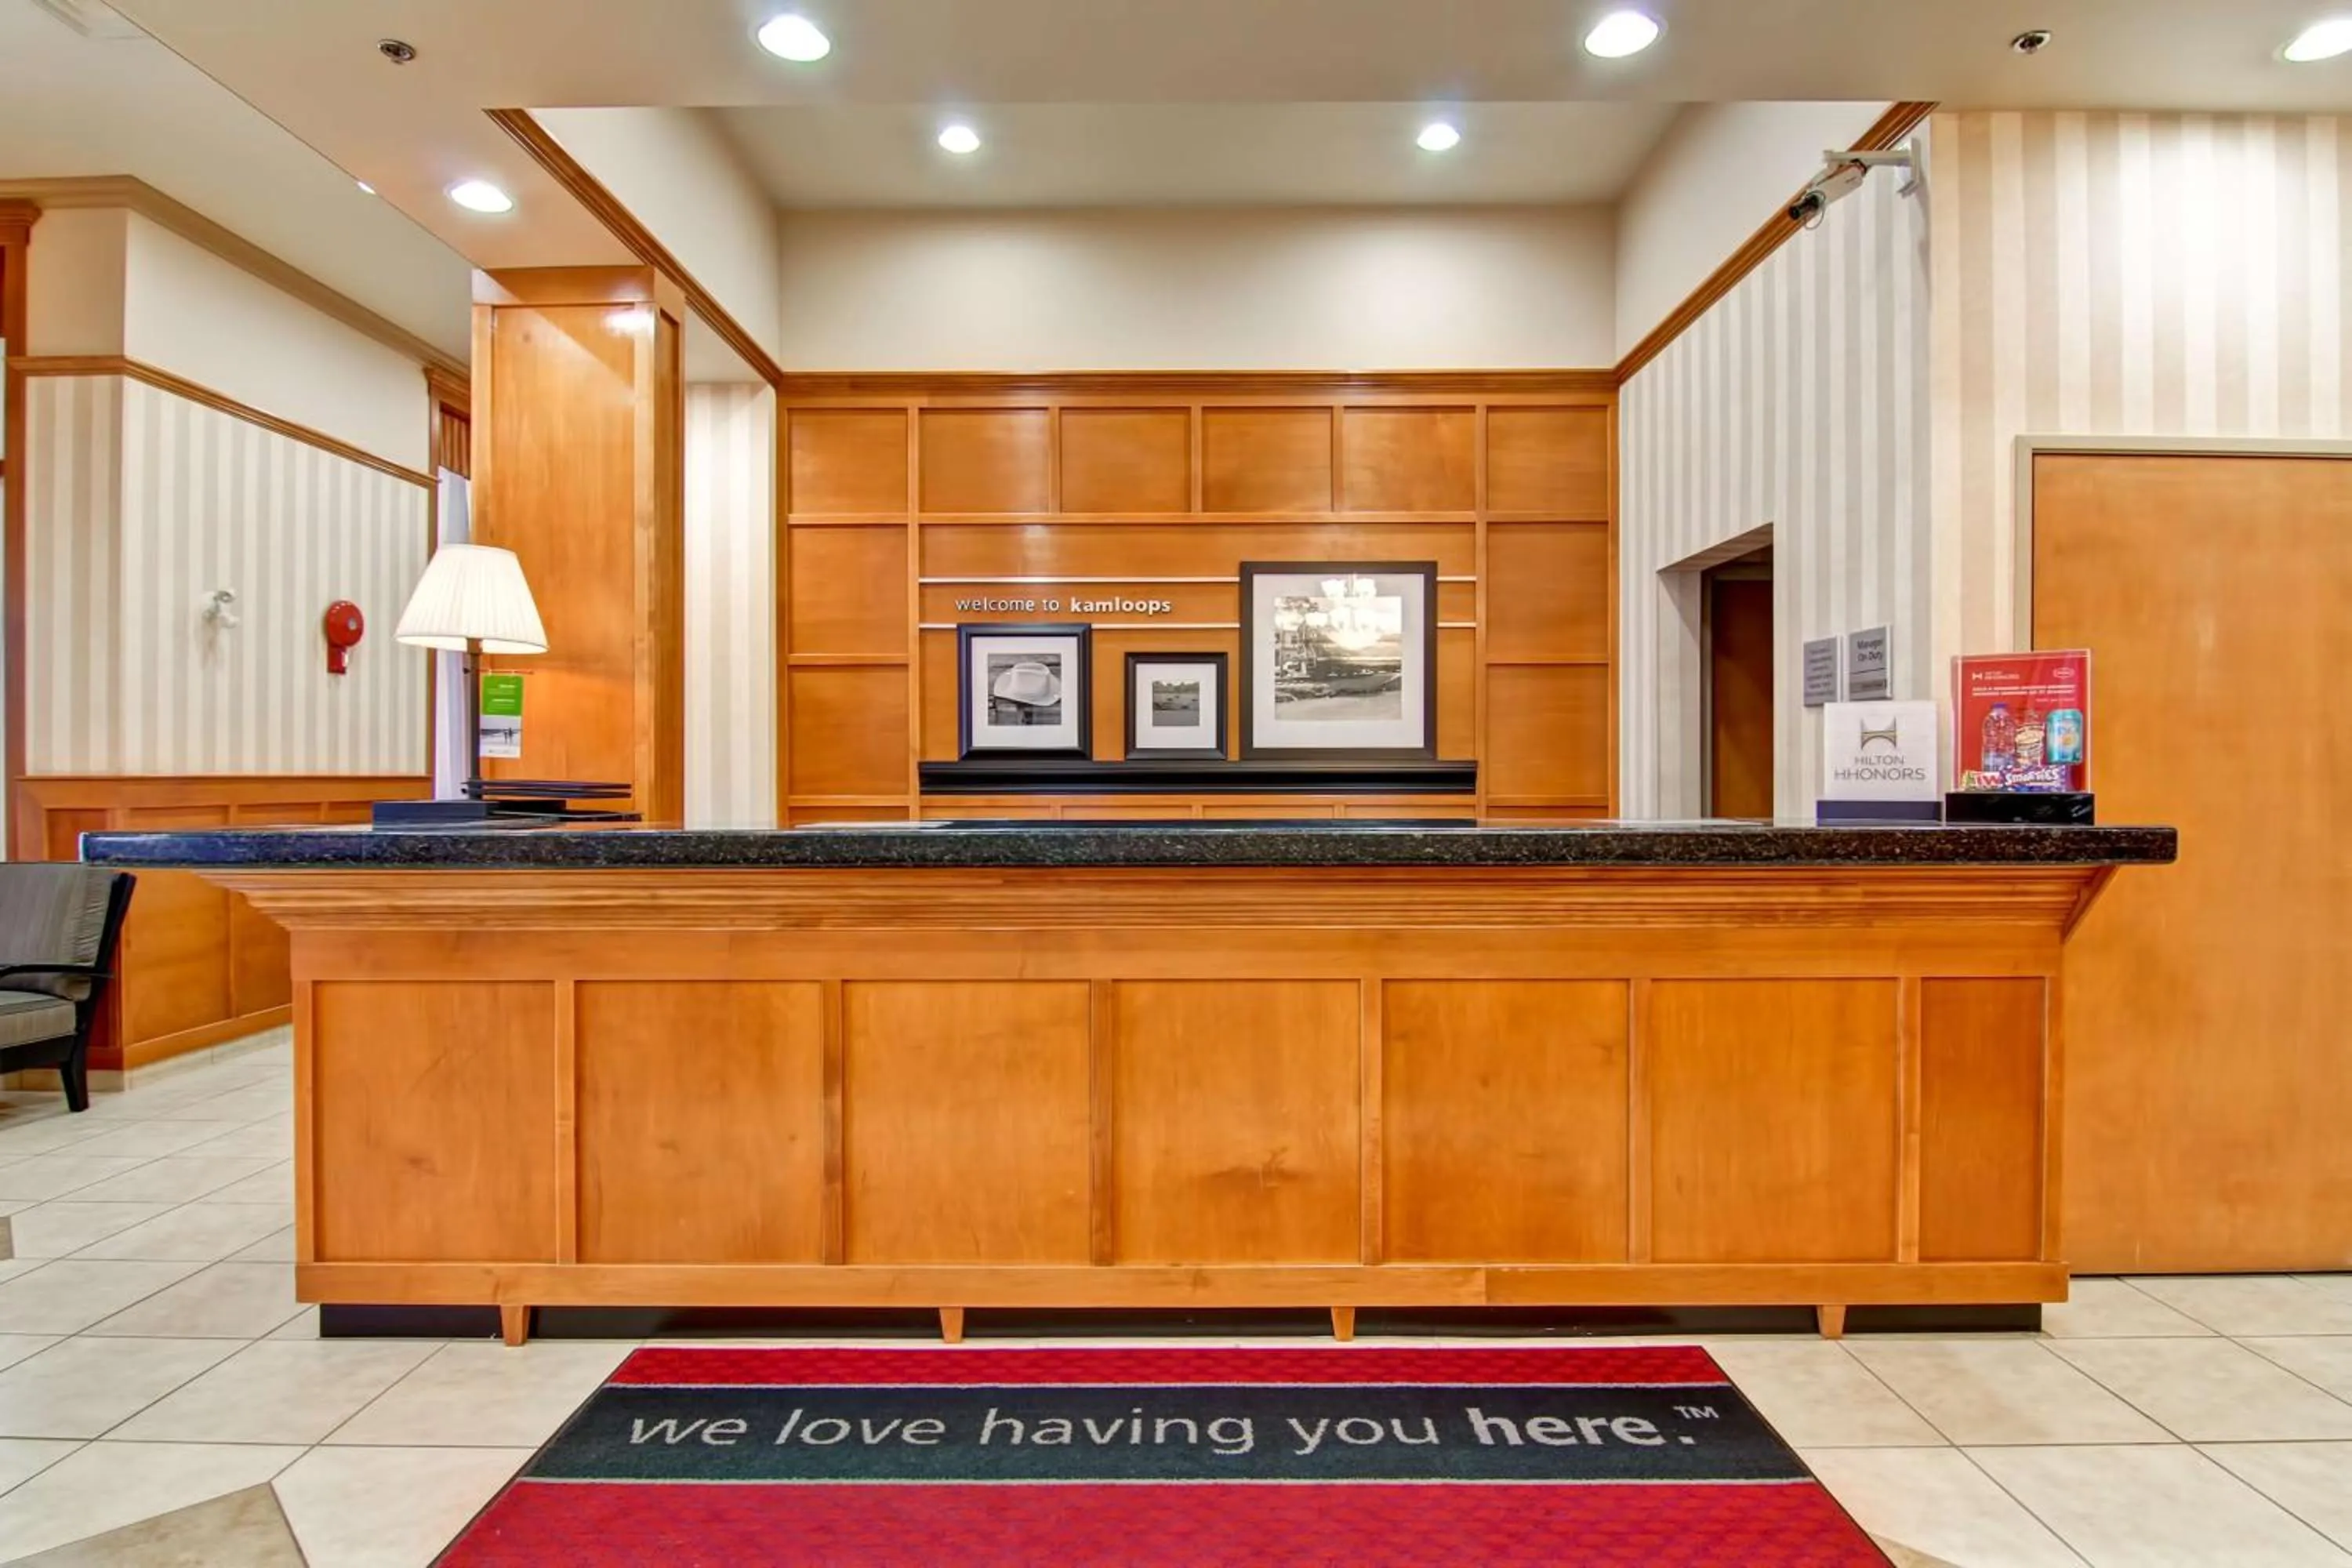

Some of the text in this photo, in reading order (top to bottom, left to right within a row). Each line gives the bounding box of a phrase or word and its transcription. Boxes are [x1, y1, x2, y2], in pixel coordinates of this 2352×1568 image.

[955, 597, 1171, 615] welcome to kamloops
[1854, 754, 1905, 766] HILTON
[1834, 768, 1926, 781] HHONORS
[630, 1417, 748, 1446] we
[775, 1408, 946, 1446] love
[978, 1407, 1255, 1455] having
[1287, 1417, 1441, 1456] you
